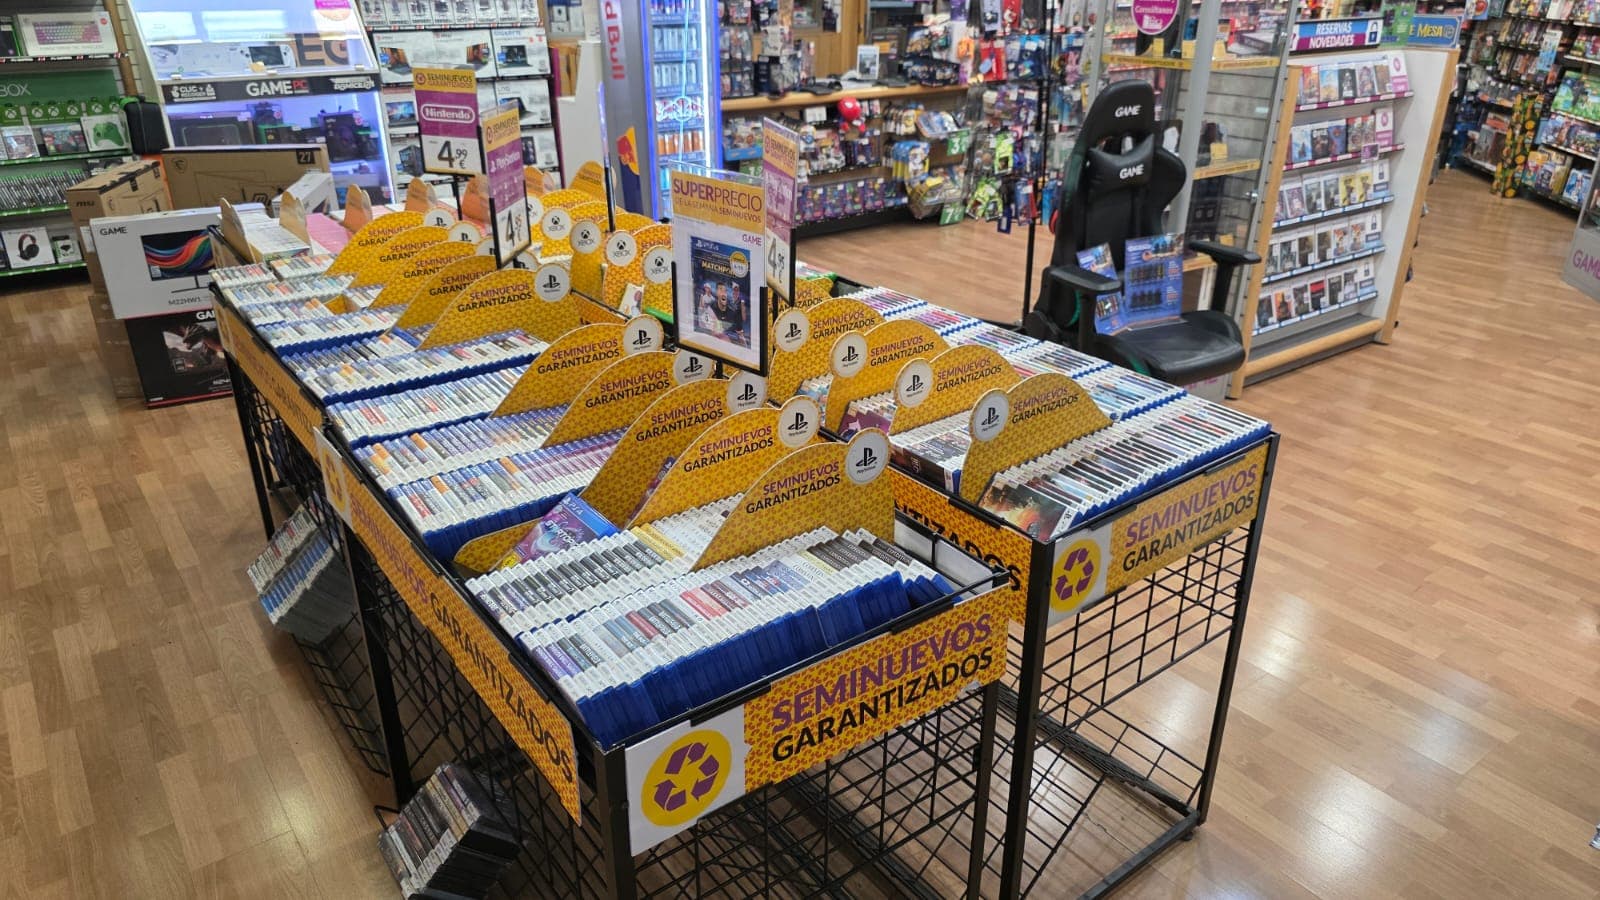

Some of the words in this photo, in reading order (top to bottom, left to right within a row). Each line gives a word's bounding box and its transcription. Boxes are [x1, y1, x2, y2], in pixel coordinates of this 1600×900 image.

[1316, 22, 1352, 34] RESERVAS
[1417, 23, 1444, 38] MESA
[1309, 34, 1355, 49] NOVEDADES
[246, 81, 293, 97] GAME
[293, 80, 309, 89] PC
[424, 107, 471, 120] Nintendo
[1115, 104, 1142, 118] GAME
[300, 151, 312, 163] 27
[1119, 164, 1144, 180] GAME
[673, 178, 763, 213] SUPERPRECIO
[719, 207, 762, 224] SEMINUEVOS
[100, 226, 128, 236] GAME
[742, 234, 763, 247] GAME
[458, 292, 532, 313] GARANTIZADOS
[470, 282, 530, 300] SEMINUEVOS
[813, 317, 876, 340] GARANTIZADOS
[814, 310, 865, 329] SEMINUEVOS
[552, 338, 618, 361] SEMINUEVOS
[870, 336, 924, 358] SEMINUEVOS
[870, 342, 935, 367] GARANTIZADOS
[538, 349, 620, 375] GARANTIZADOS
[937, 357, 991, 380] SEMINUEVOS
[600, 369, 669, 393] SEMINUEVOS
[936, 365, 1002, 392] GARANTIZADOS
[585, 379, 671, 408] GARANTIZADOS
[1013, 386, 1069, 412] SEMINUEVOS
[651, 397, 722, 425] SEMINUEVOS
[1011, 393, 1079, 425] GARANTIZADOS
[636, 408, 724, 442] GARANTIZADOS
[699, 425, 772, 456] SEMINUEVOS
[684, 437, 774, 473] GARANTIZADOS
[763, 461, 840, 496] SEMINUEVOS
[746, 473, 841, 514] GARANTIZADOS
[569, 501, 584, 516] PS4
[1124, 463, 1258, 549] SEMINUEVOS
[1121, 490, 1255, 573] GARANTIZADOS
[771, 613, 993, 733] SEMINUEVOS
[429, 591, 575, 785] GARANTIZADOS
[772, 646, 993, 762] GARANTIZADOS
